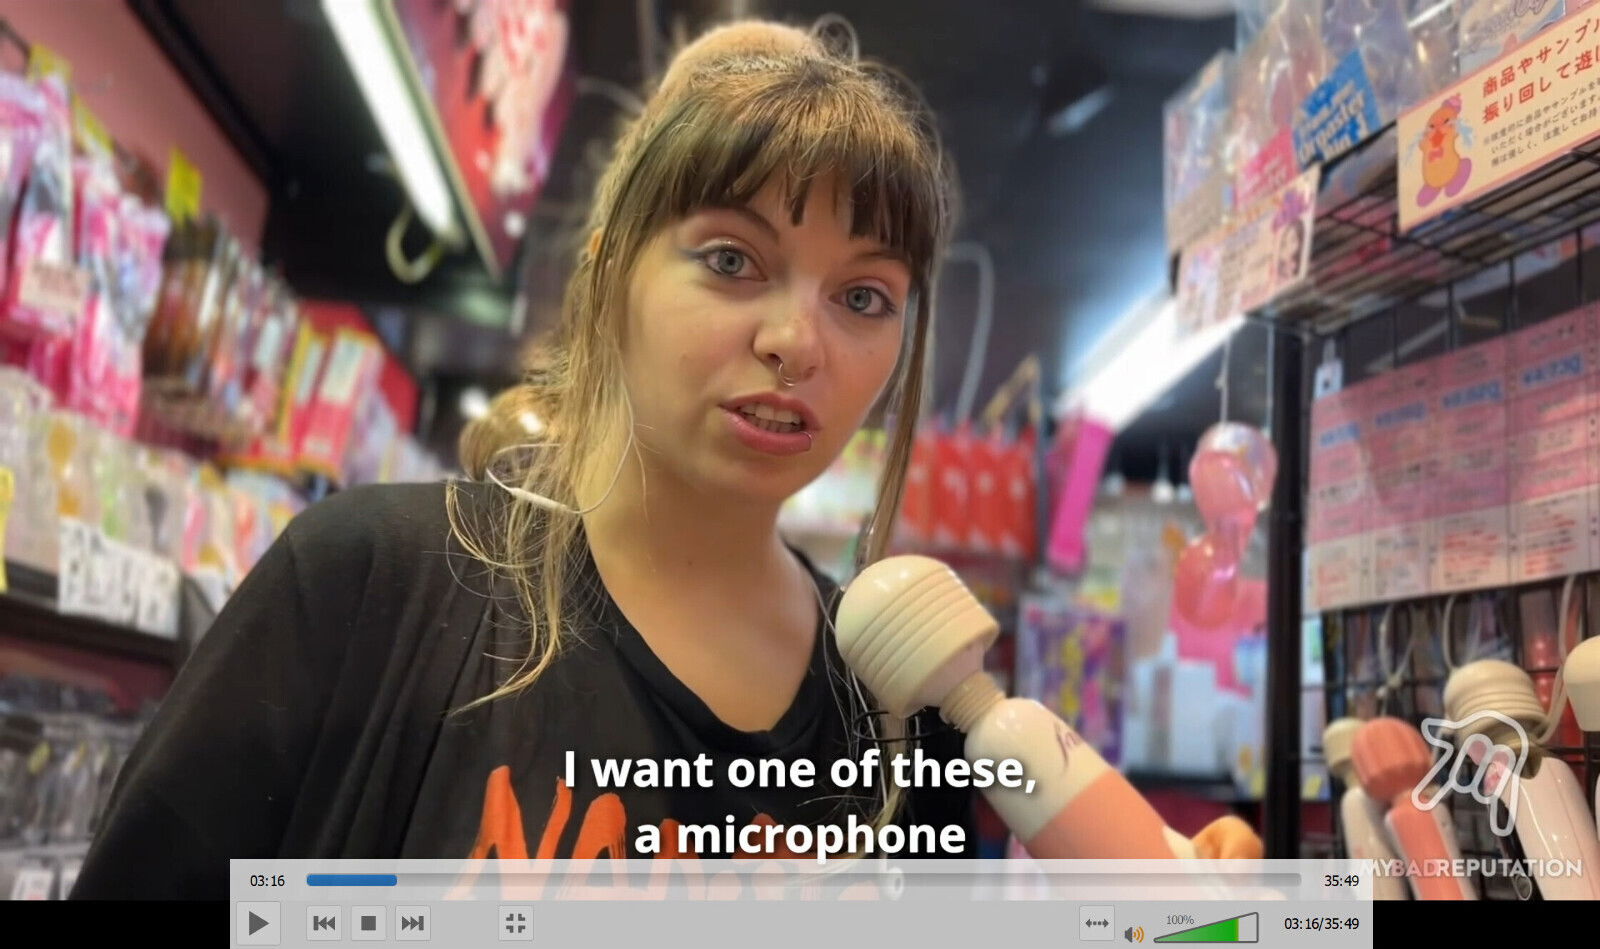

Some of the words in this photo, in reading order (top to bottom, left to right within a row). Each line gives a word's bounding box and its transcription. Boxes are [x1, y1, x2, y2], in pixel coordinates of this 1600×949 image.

[249, 874, 286, 888] 03:16
[1323, 874, 1360, 888] 35:49
[1166, 914, 1196, 926] 100%
[1283, 917, 1360, 932] 03:16/35:49
